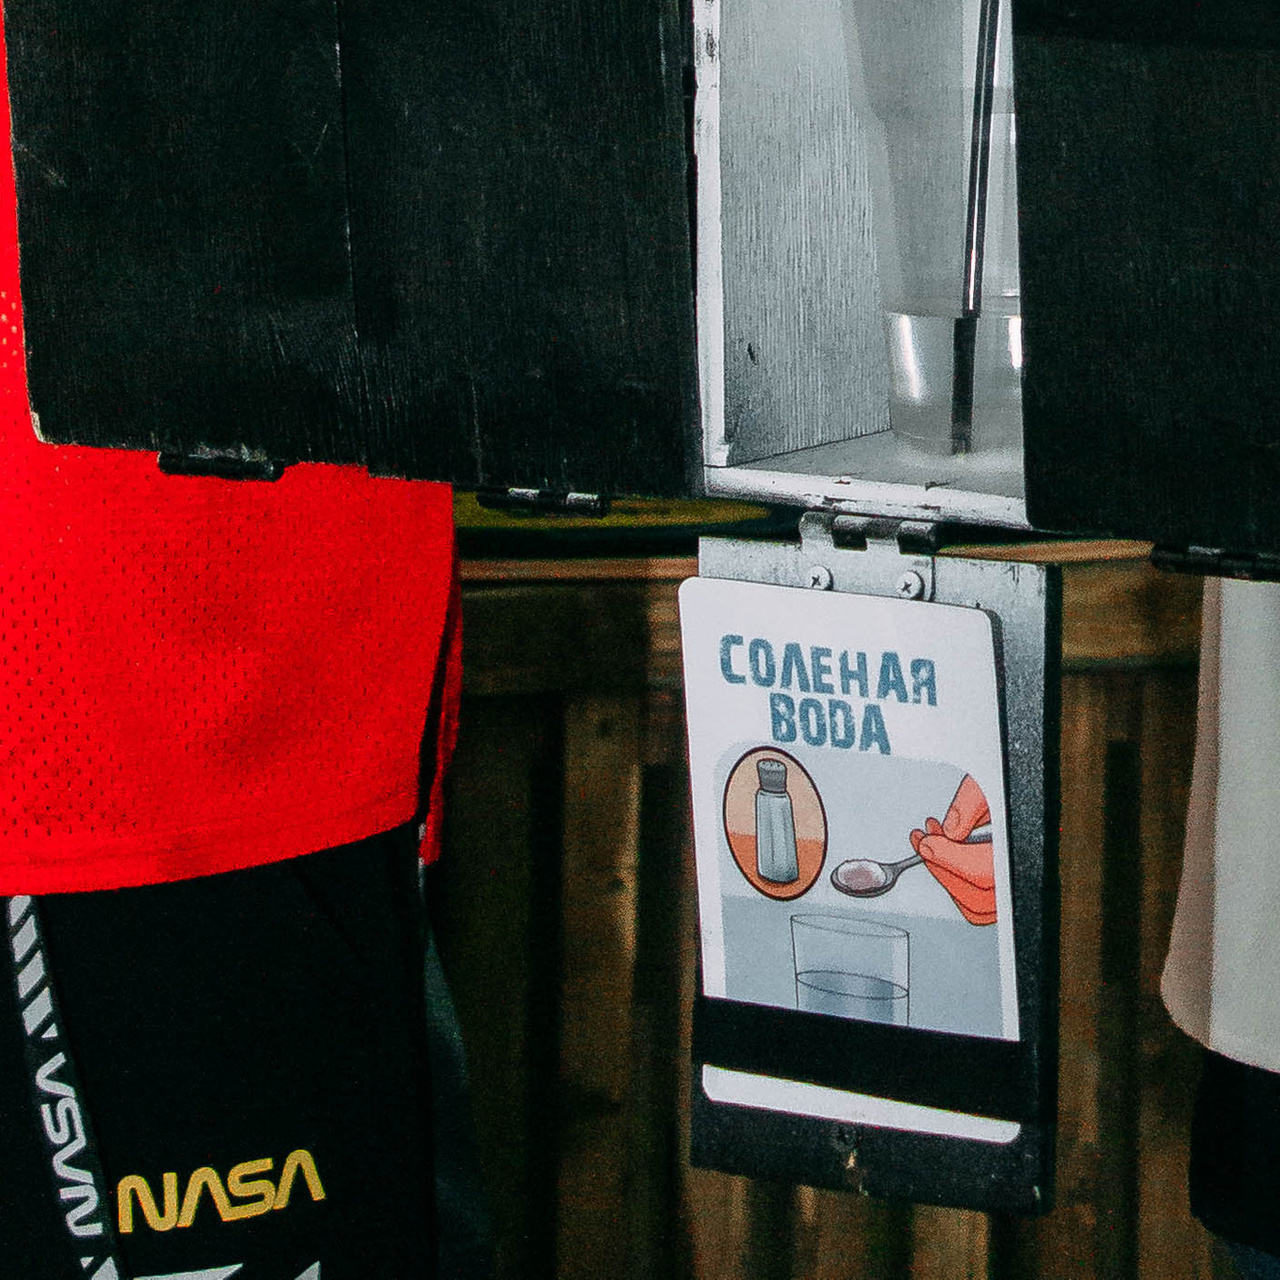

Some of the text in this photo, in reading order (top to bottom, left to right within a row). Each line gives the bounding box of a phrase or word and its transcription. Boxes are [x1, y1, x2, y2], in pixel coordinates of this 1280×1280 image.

[719, 634, 938, 707] СОЛЕНАЯ
[35, 1051, 104, 1238] NASA
[117, 1149, 327, 1234] NASA
